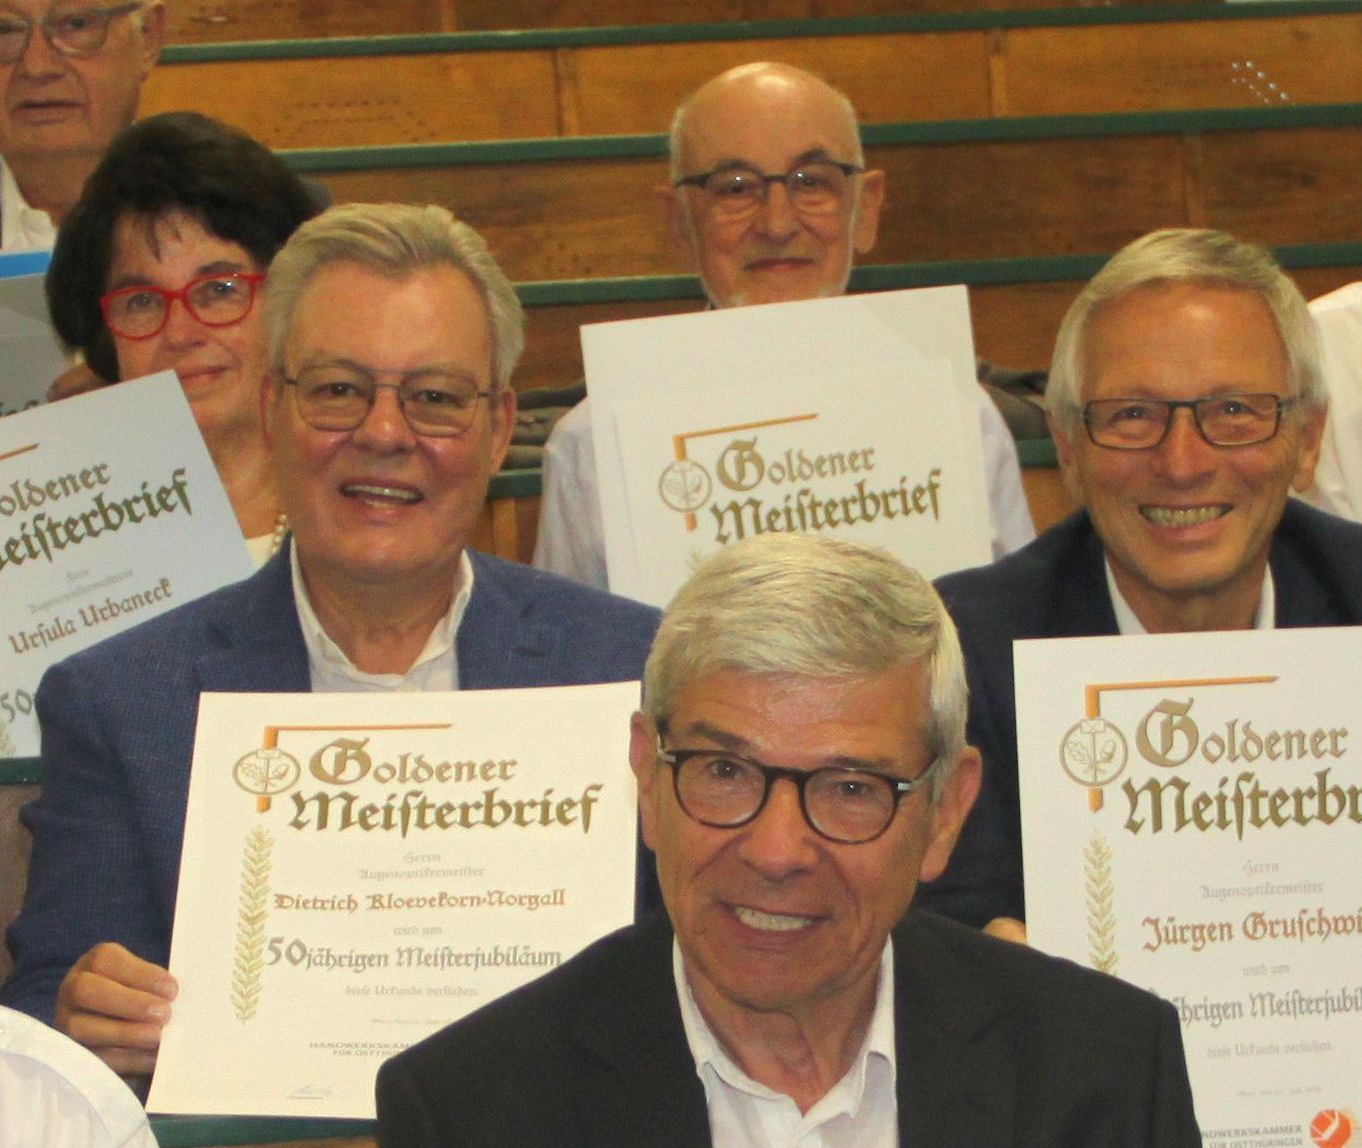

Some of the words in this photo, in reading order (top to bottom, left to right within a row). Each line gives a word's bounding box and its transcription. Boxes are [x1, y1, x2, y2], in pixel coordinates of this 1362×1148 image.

[716, 437, 876, 492] Goldener
[78, 577, 173, 627] Urbaneck
[1135, 697, 1350, 767] Goldener
[309, 737, 518, 786] Goldener
[273, 893, 358, 914] Dietrich
[267, 937, 389, 973] 50jährigen
[1141, 915, 1234, 952] Jürgen
